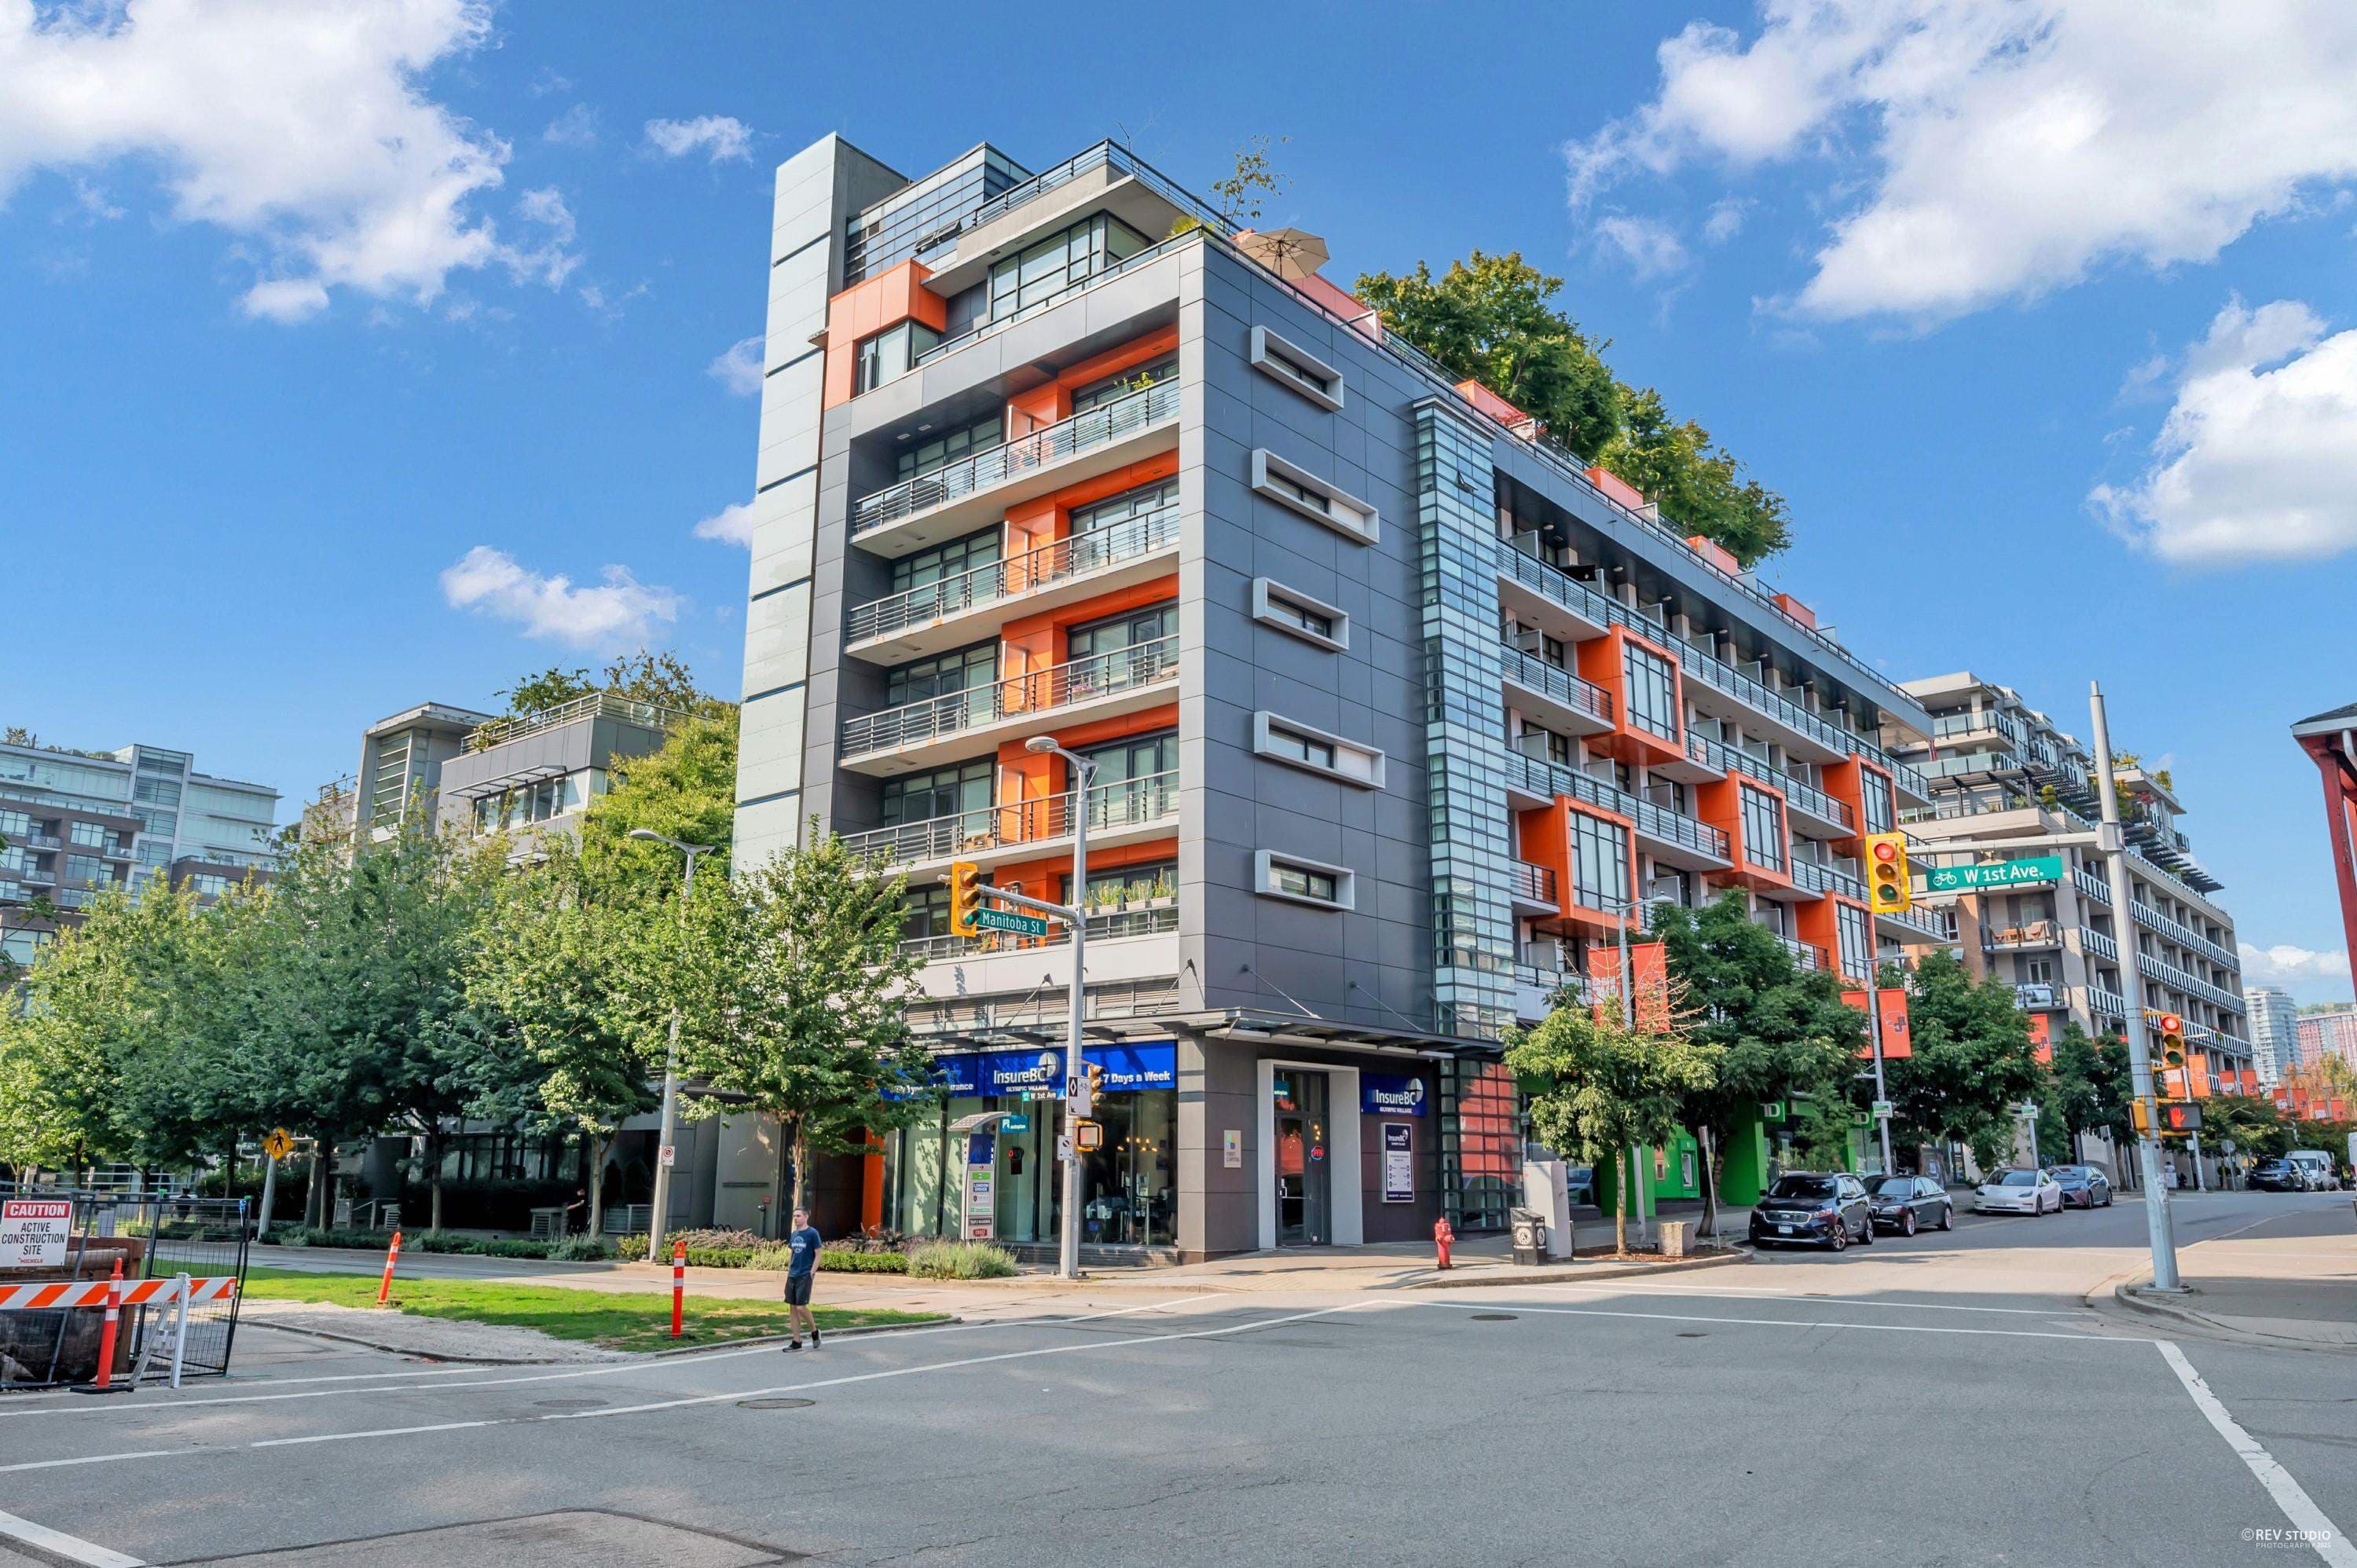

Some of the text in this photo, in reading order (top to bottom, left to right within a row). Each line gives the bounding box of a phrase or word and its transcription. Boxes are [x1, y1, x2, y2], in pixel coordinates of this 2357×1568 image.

[1964, 865, 2044, 884] W 1st Ave.
[983, 912, 1039, 933] Manitoba St
[994, 1067, 1046, 1084] InsureBC
[1103, 1074, 1109, 1083] 7
[1111, 1073, 1134, 1085] Days
[1144, 1071, 1171, 1081] Week
[1376, 1090, 1416, 1105] InsureBC
[1760, 1103, 1780, 1117] TD
[9, 1204, 66, 1217] CAUTION
[20, 1222, 50, 1232] ACTIVE
[2, 1233, 65, 1244] CONSTRUCTION
[23, 1245, 42, 1255] SITE
